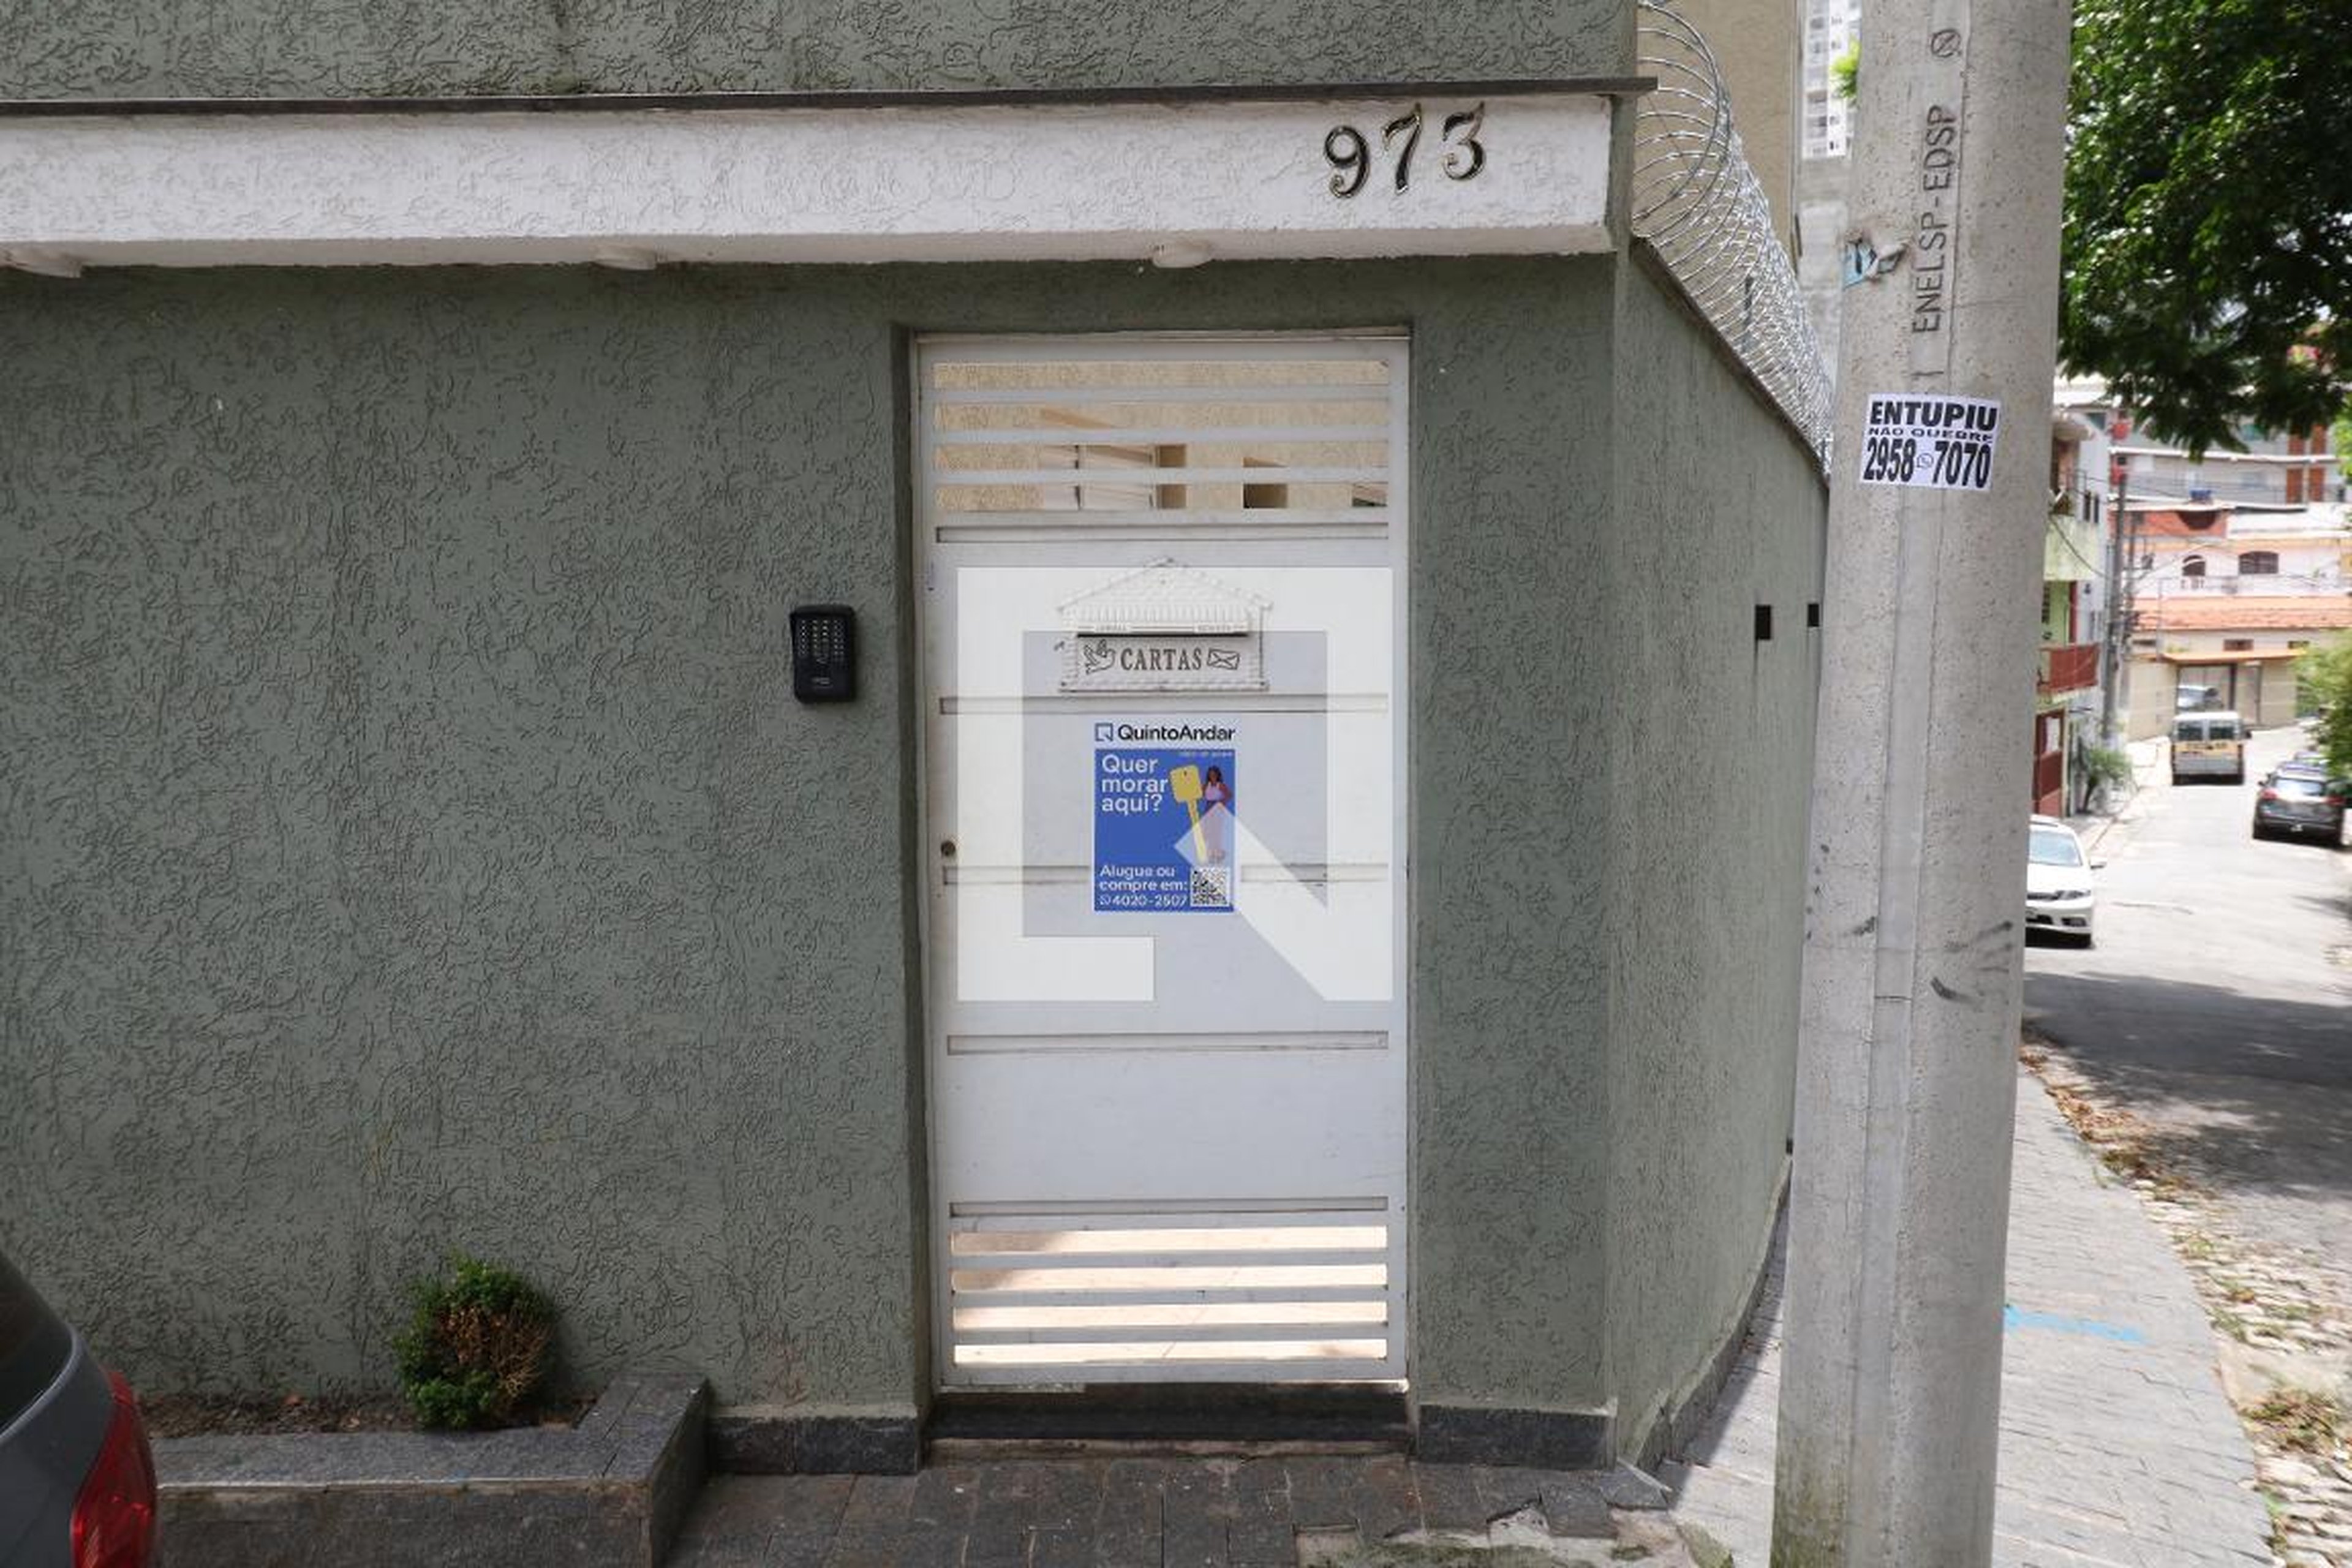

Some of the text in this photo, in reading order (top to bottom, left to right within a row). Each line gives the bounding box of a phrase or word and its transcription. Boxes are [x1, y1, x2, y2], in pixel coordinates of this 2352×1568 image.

[1323, 101, 1487, 198] 973
[1869, 401, 1997, 431] ENTUPIU
[1863, 437, 1991, 488] 2958 7070
[1120, 647, 1203, 671] CARTAS
[1117, 724, 1236, 741] QuintoAndar
[1101, 754, 1158, 774] Quer
[1101, 777, 1169, 793] morar
[1101, 794, 1163, 815] aqui?
[1099, 865, 1175, 880] Alugue ou
[1099, 880, 1188, 892] compre em:
